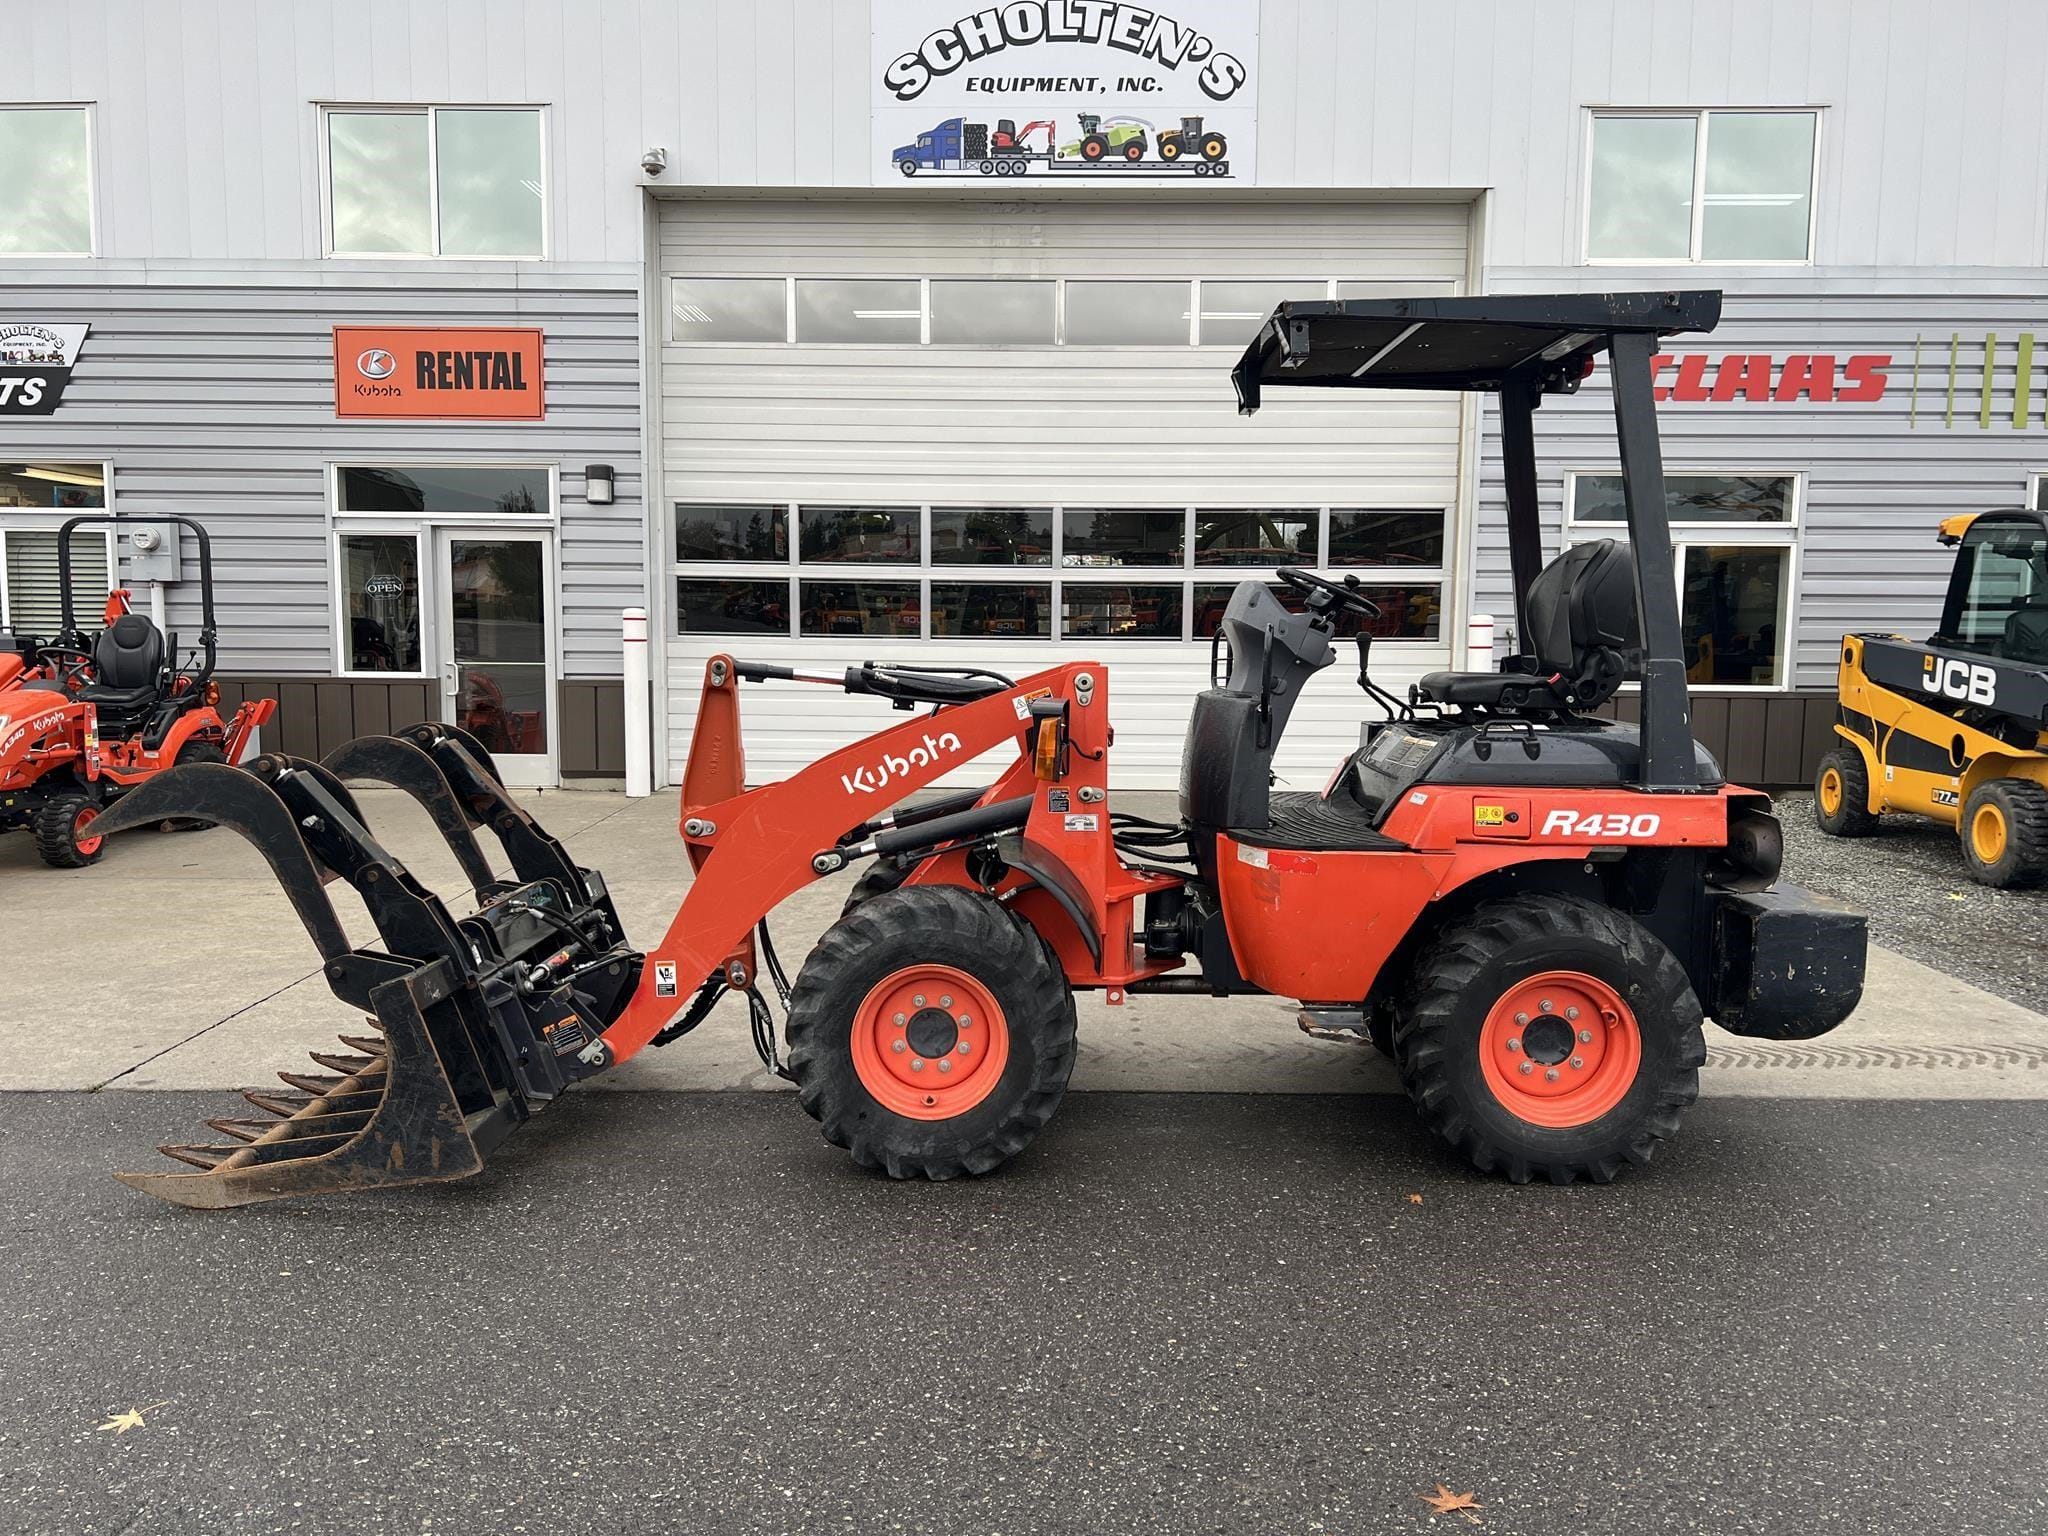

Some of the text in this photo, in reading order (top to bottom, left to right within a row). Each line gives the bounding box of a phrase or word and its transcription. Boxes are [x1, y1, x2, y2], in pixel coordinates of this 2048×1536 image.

[883, 0, 1247, 102] SCHOLTEN'S
[965, 76, 1164, 95] EQUIPMENT, INC.
[0, 324, 65, 349] HOLTEN'S
[415, 350, 528, 391] RENTAL
[1649, 354, 1893, 402] CLAAS
[354, 384, 402, 397] Kubota
[367, 584, 402, 593] OPEN
[1922, 657, 1997, 706] JCB
[33, 711, 65, 731] Kubota
[841, 731, 962, 796] Kubota
[1540, 809, 1661, 838] R430
